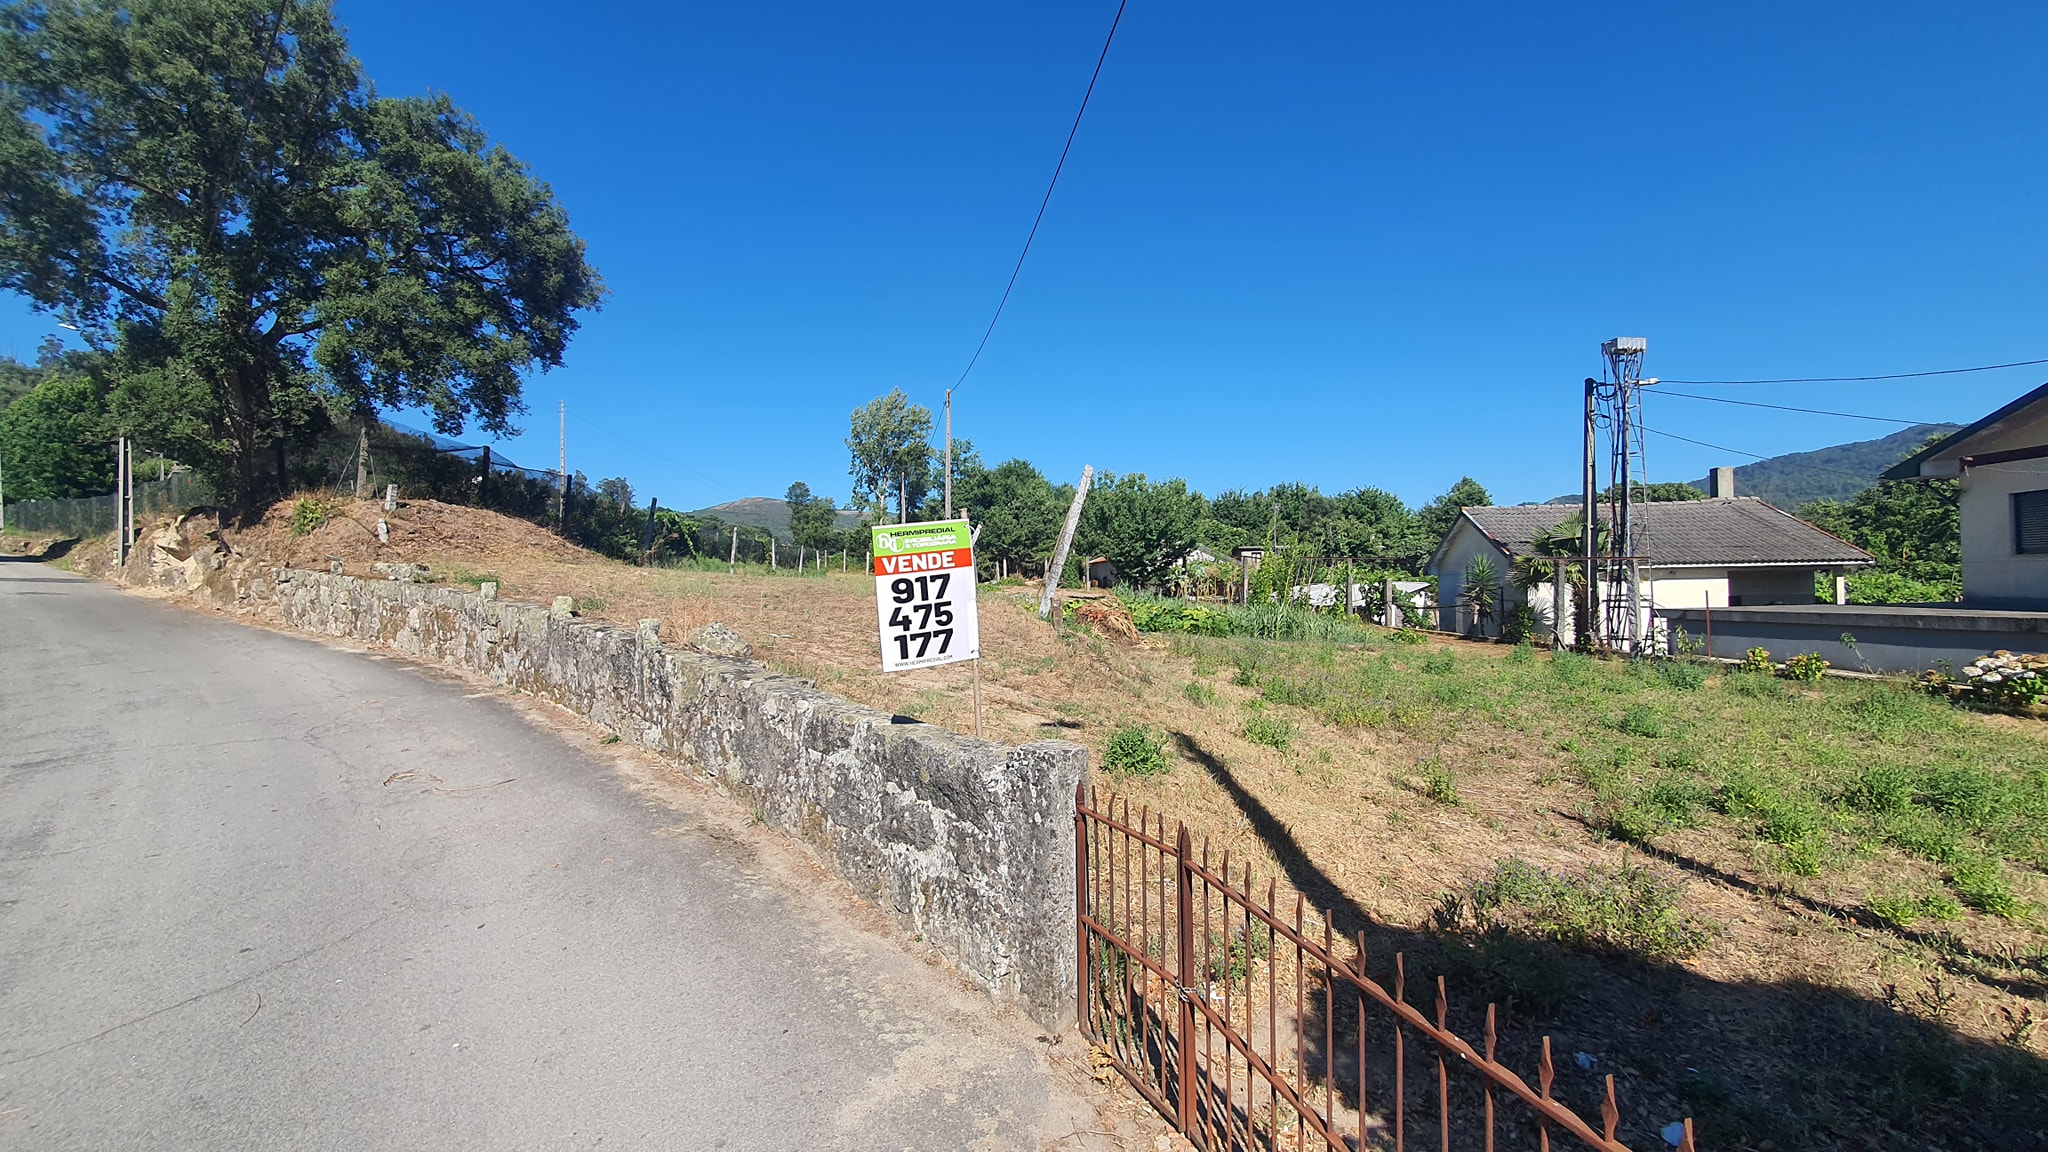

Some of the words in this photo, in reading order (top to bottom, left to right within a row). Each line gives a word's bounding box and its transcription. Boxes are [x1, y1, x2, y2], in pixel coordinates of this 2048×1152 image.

[890, 527, 956, 537] HERMIPREDIAL
[881, 551, 956, 574] VENDE
[891, 573, 951, 604] 917
[888, 601, 954, 632] 475
[893, 628, 954, 660] 177
